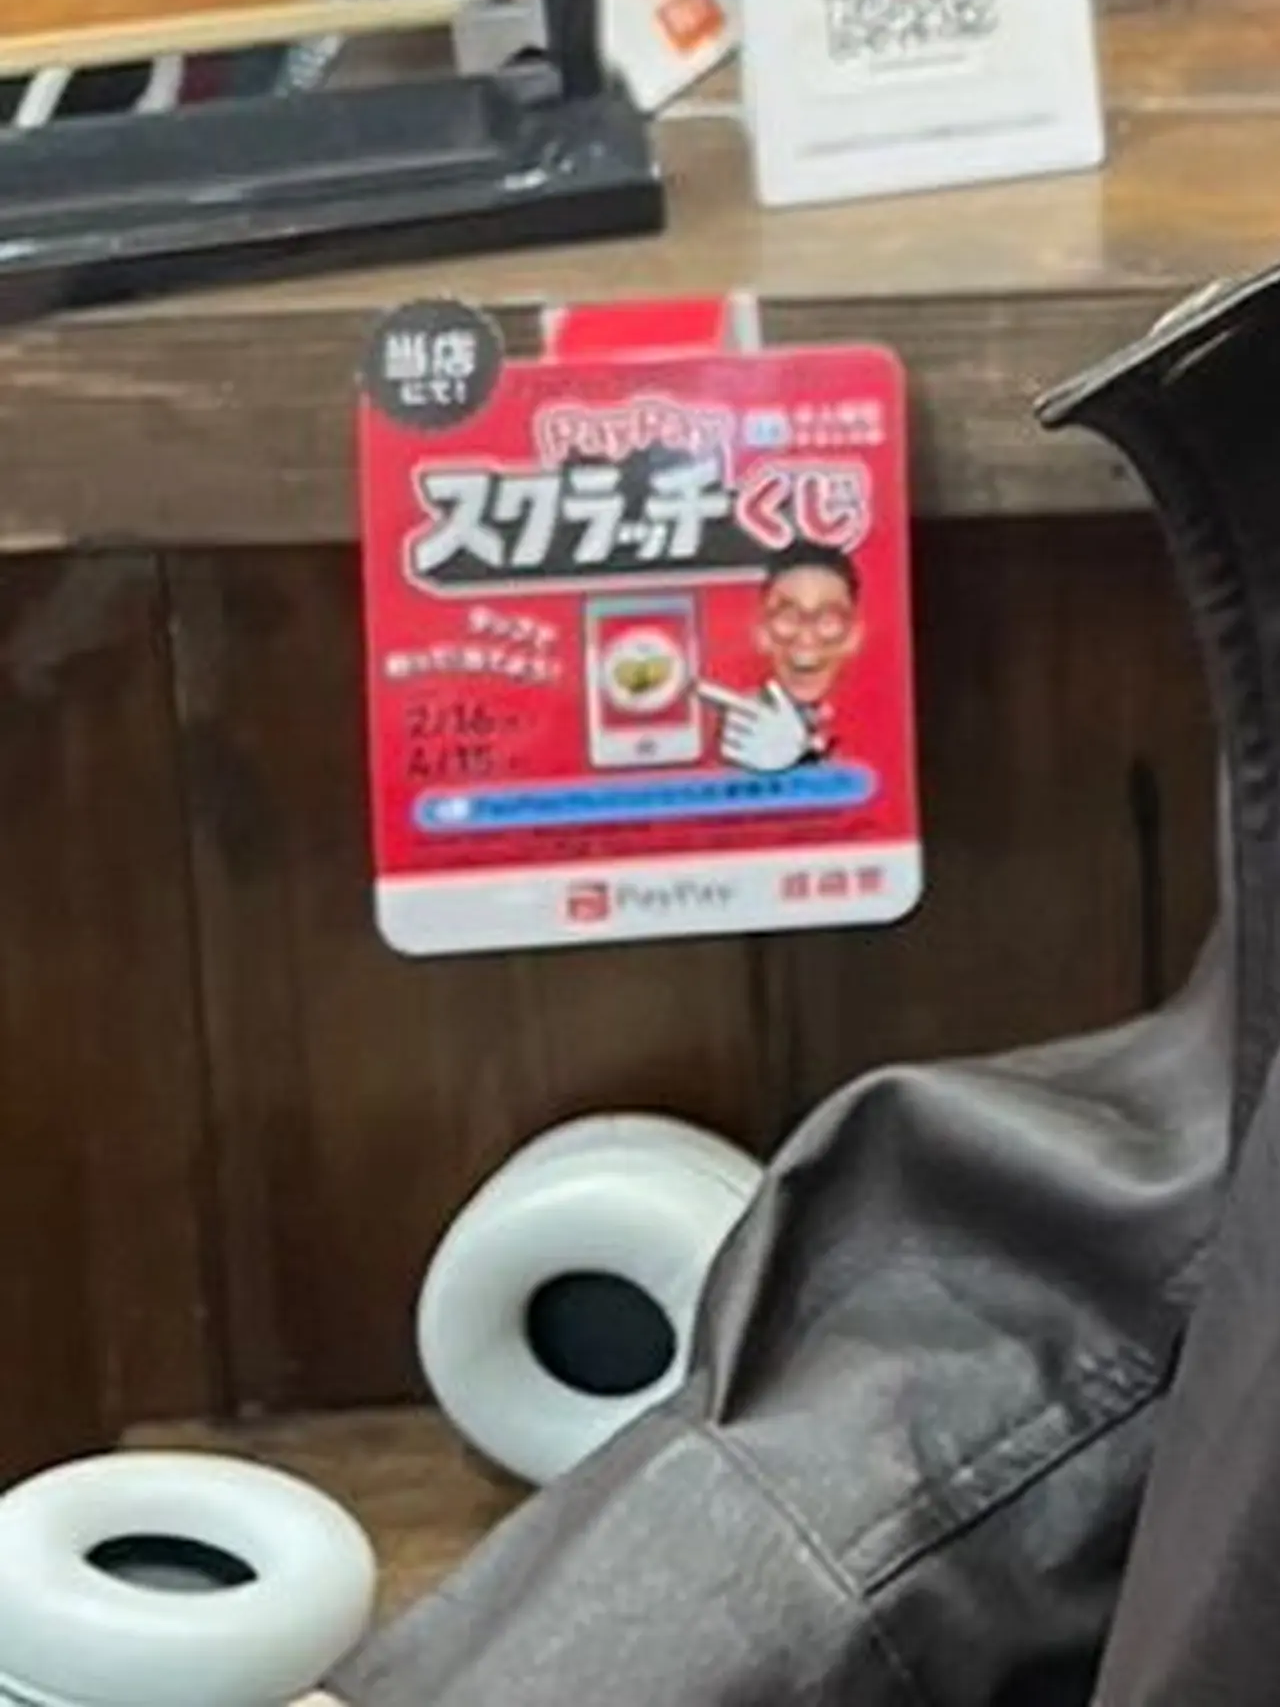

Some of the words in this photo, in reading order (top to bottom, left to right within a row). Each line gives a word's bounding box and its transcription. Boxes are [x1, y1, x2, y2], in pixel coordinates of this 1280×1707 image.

[386, 331, 476, 379] 当店
[539, 397, 733, 479] PayPay
[416, 455, 868, 569] スクラッチくじ
[616, 877, 735, 912] PayPay
